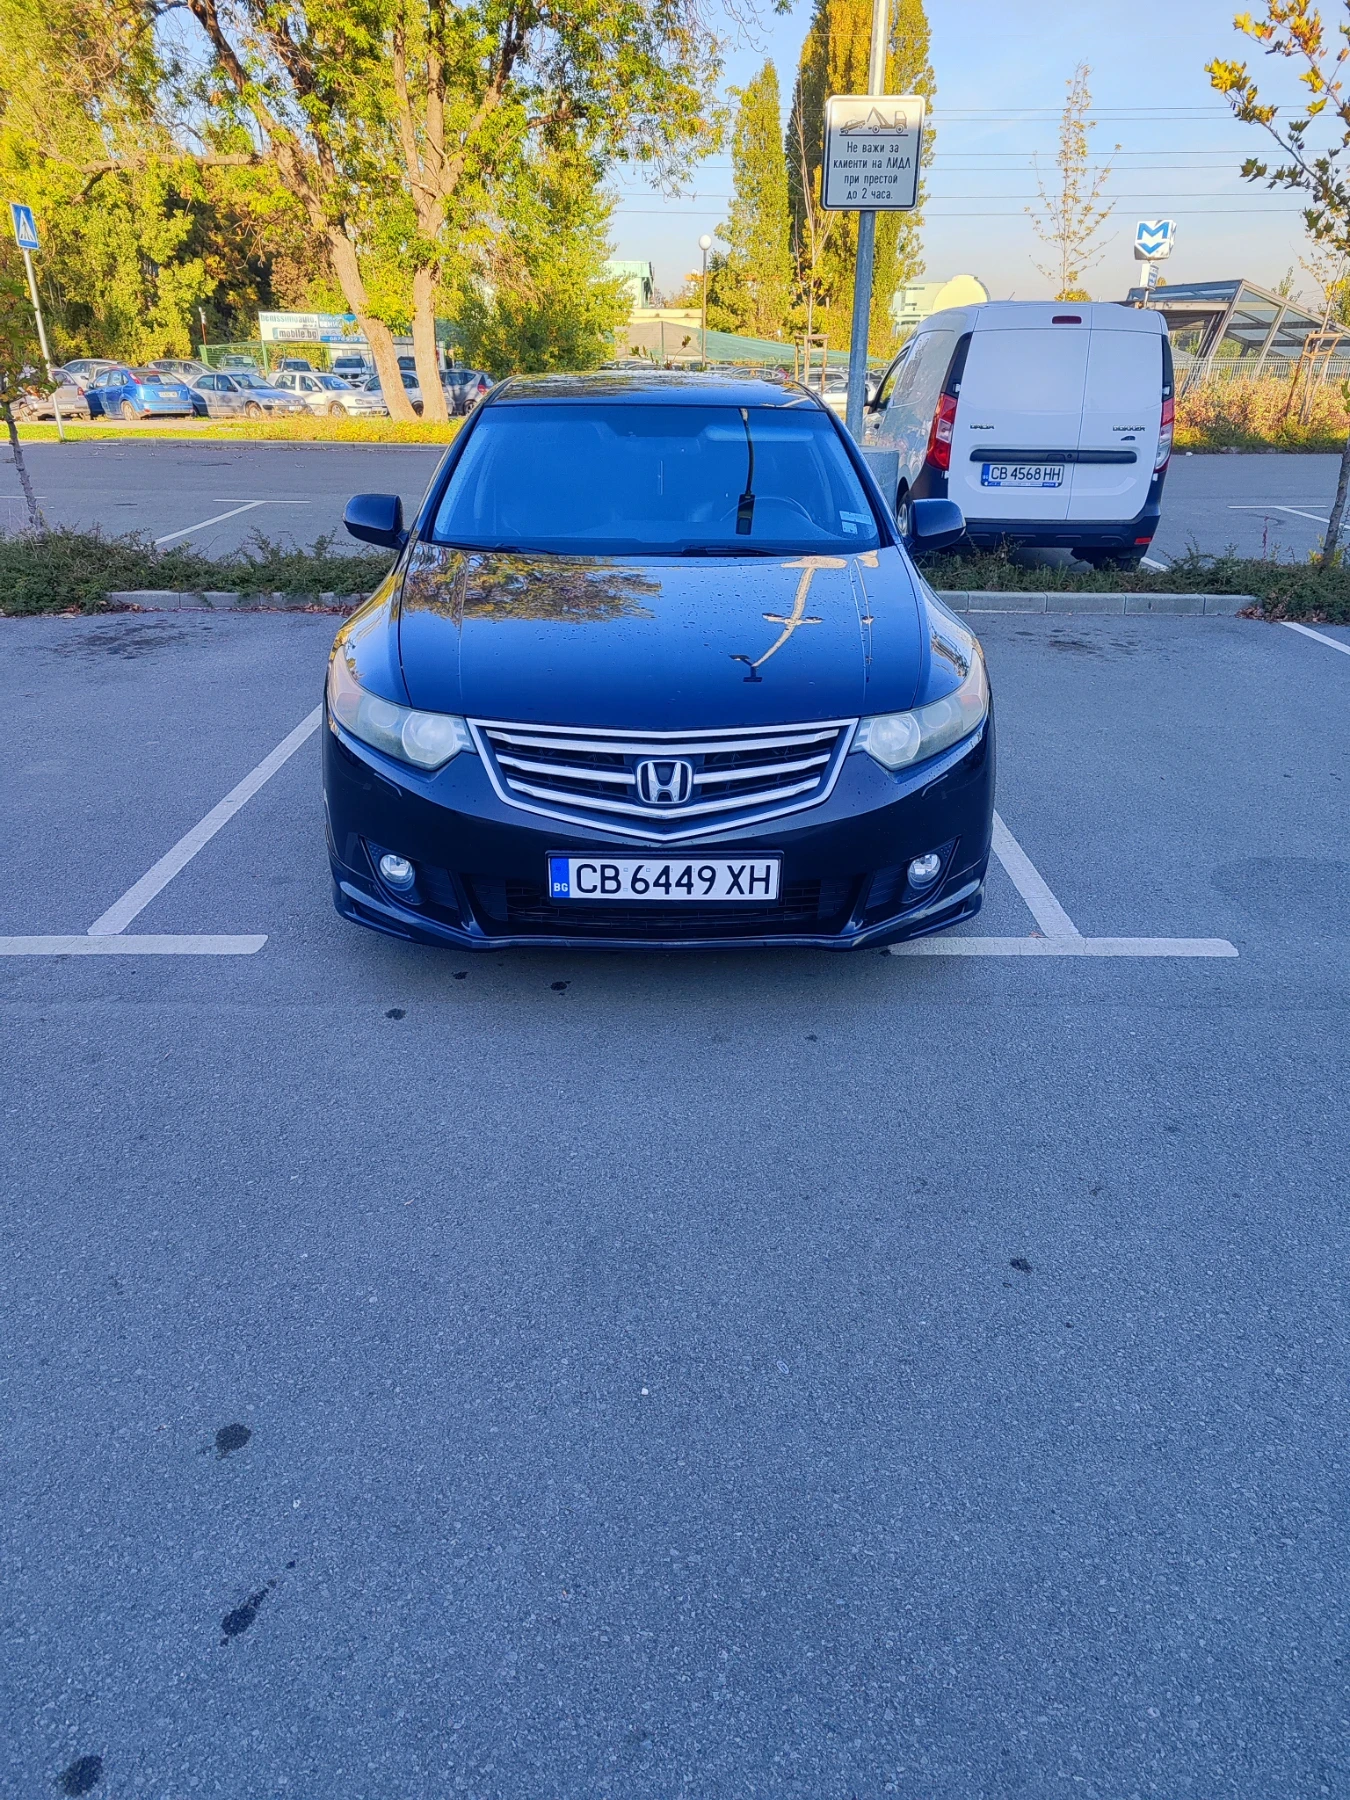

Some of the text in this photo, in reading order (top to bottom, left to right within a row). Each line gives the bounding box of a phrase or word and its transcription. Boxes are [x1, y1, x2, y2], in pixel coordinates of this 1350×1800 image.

[846, 141, 900, 153] Не важи за
[833, 157, 911, 170] клиенти на ЛИДЛ
[844, 174, 898, 187] при престой
[846, 187, 893, 200] до 2 часа.
[279, 329, 317, 340] mobile.bg
[991, 467, 1008, 480] CB
[1010, 467, 1042, 481] 4568
[1043, 467, 1061, 481] HH
[553, 863, 772, 895] BG CB 6449 XH
